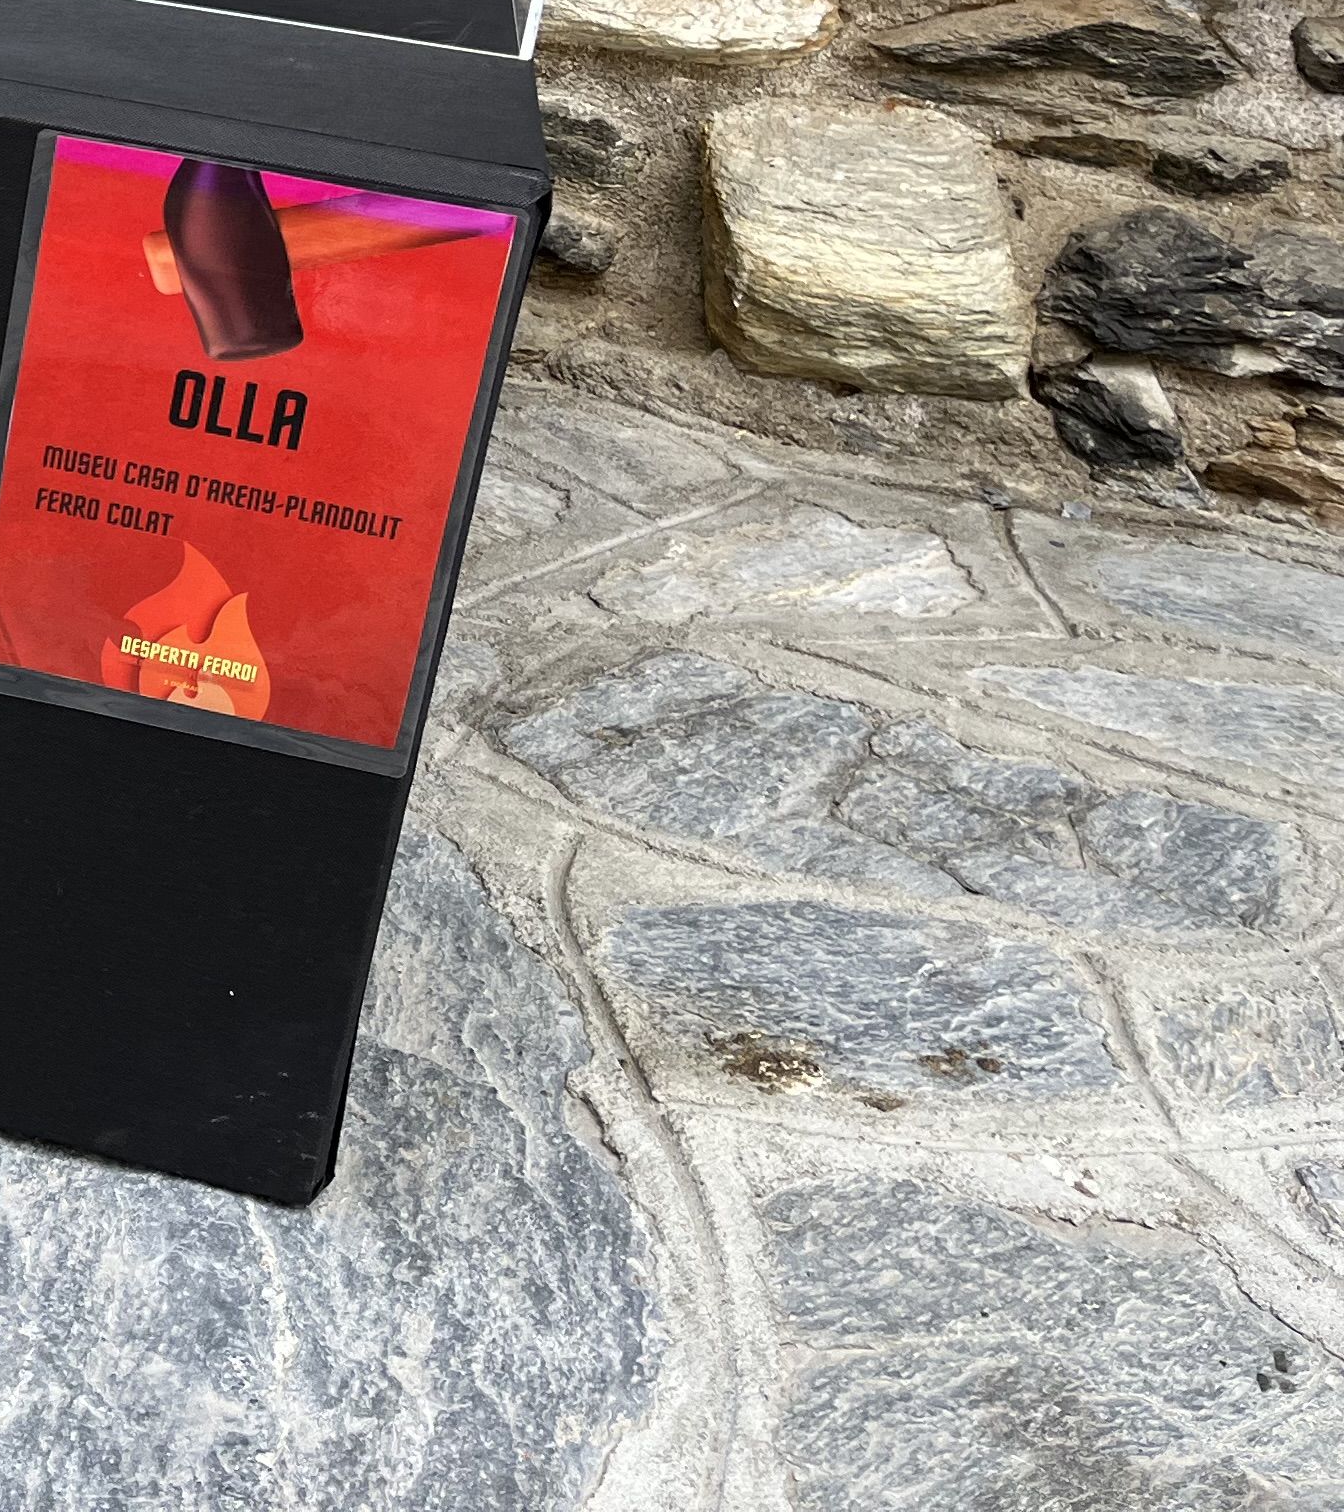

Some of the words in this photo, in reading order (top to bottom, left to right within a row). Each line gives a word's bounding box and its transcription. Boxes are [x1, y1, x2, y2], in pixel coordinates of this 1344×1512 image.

[168, 369, 308, 450] OLLA
[35, 488, 100, 520] FERRO
[106, 502, 174, 536] COLAT
[42, 445, 117, 480] MUSEU
[124, 462, 179, 494] CASA
[185, 474, 403, 540] D'ARENY-PLANDOLIT
[120, 635, 200, 669] DESPERTA
[203, 656, 258, 683] FERRO!
